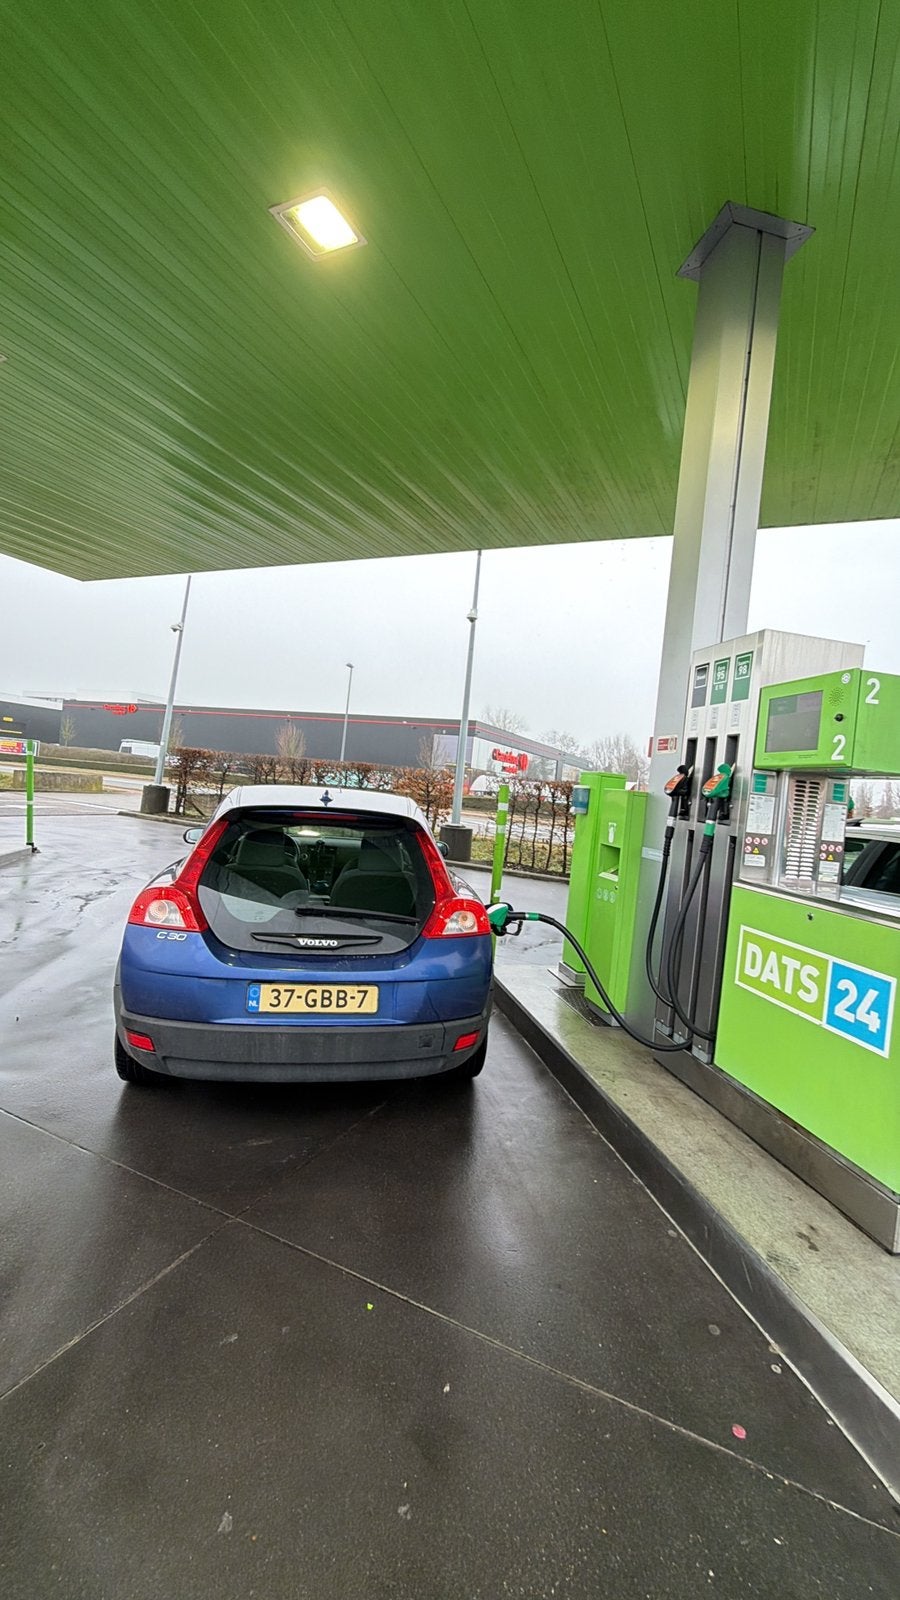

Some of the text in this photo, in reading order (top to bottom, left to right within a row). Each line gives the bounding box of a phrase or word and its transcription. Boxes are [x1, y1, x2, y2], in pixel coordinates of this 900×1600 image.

[716, 670, 725, 680] 95
[738, 665, 748, 675] 98
[865, 677, 880, 704] 2
[831, 734, 846, 760] 2
[297, 938, 338, 947] VOLVO
[744, 941, 881, 1033] DATS 24
[248, 1000, 258, 1008] NL
[269, 988, 369, 1009] 37-GBB-7
